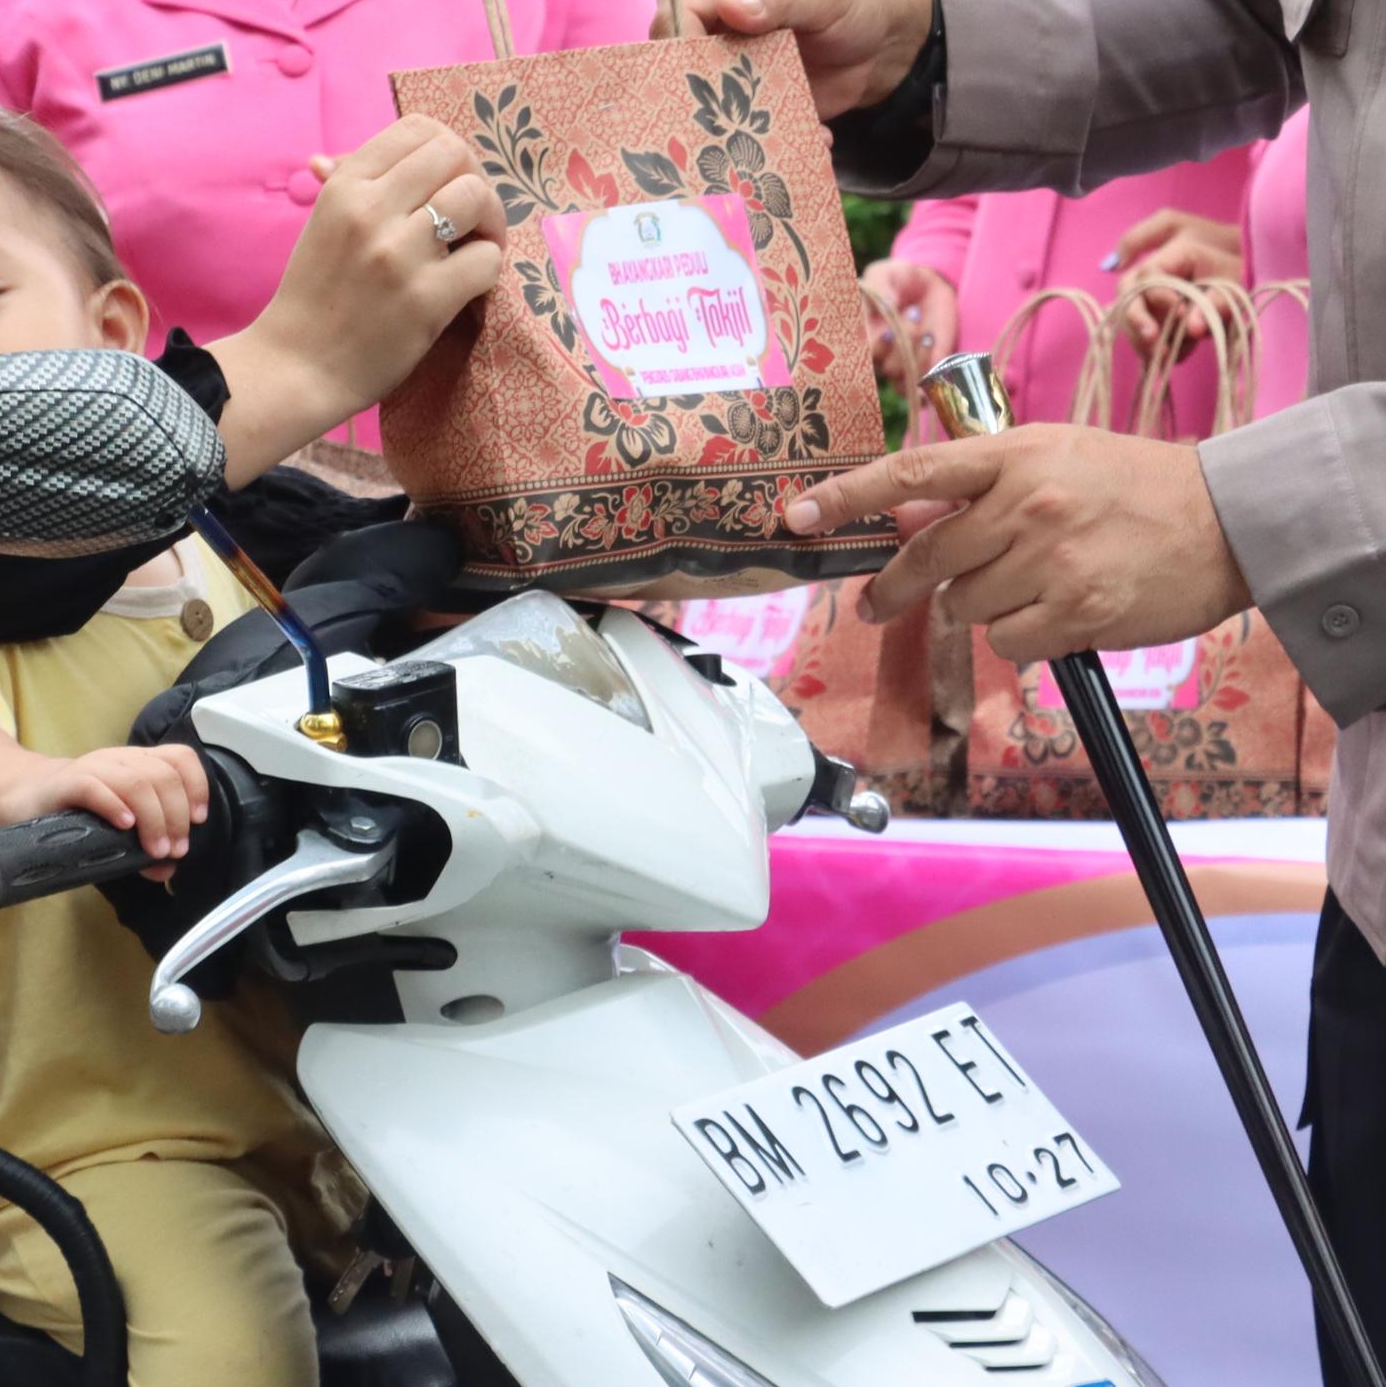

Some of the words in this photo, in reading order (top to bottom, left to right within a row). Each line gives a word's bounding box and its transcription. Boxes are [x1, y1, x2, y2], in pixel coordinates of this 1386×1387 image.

[599, 296, 690, 354] Berbagi
[692, 1103, 808, 1197] BM
[790, 1049, 956, 1163] 2692
[929, 1015, 1029, 1105] ET
